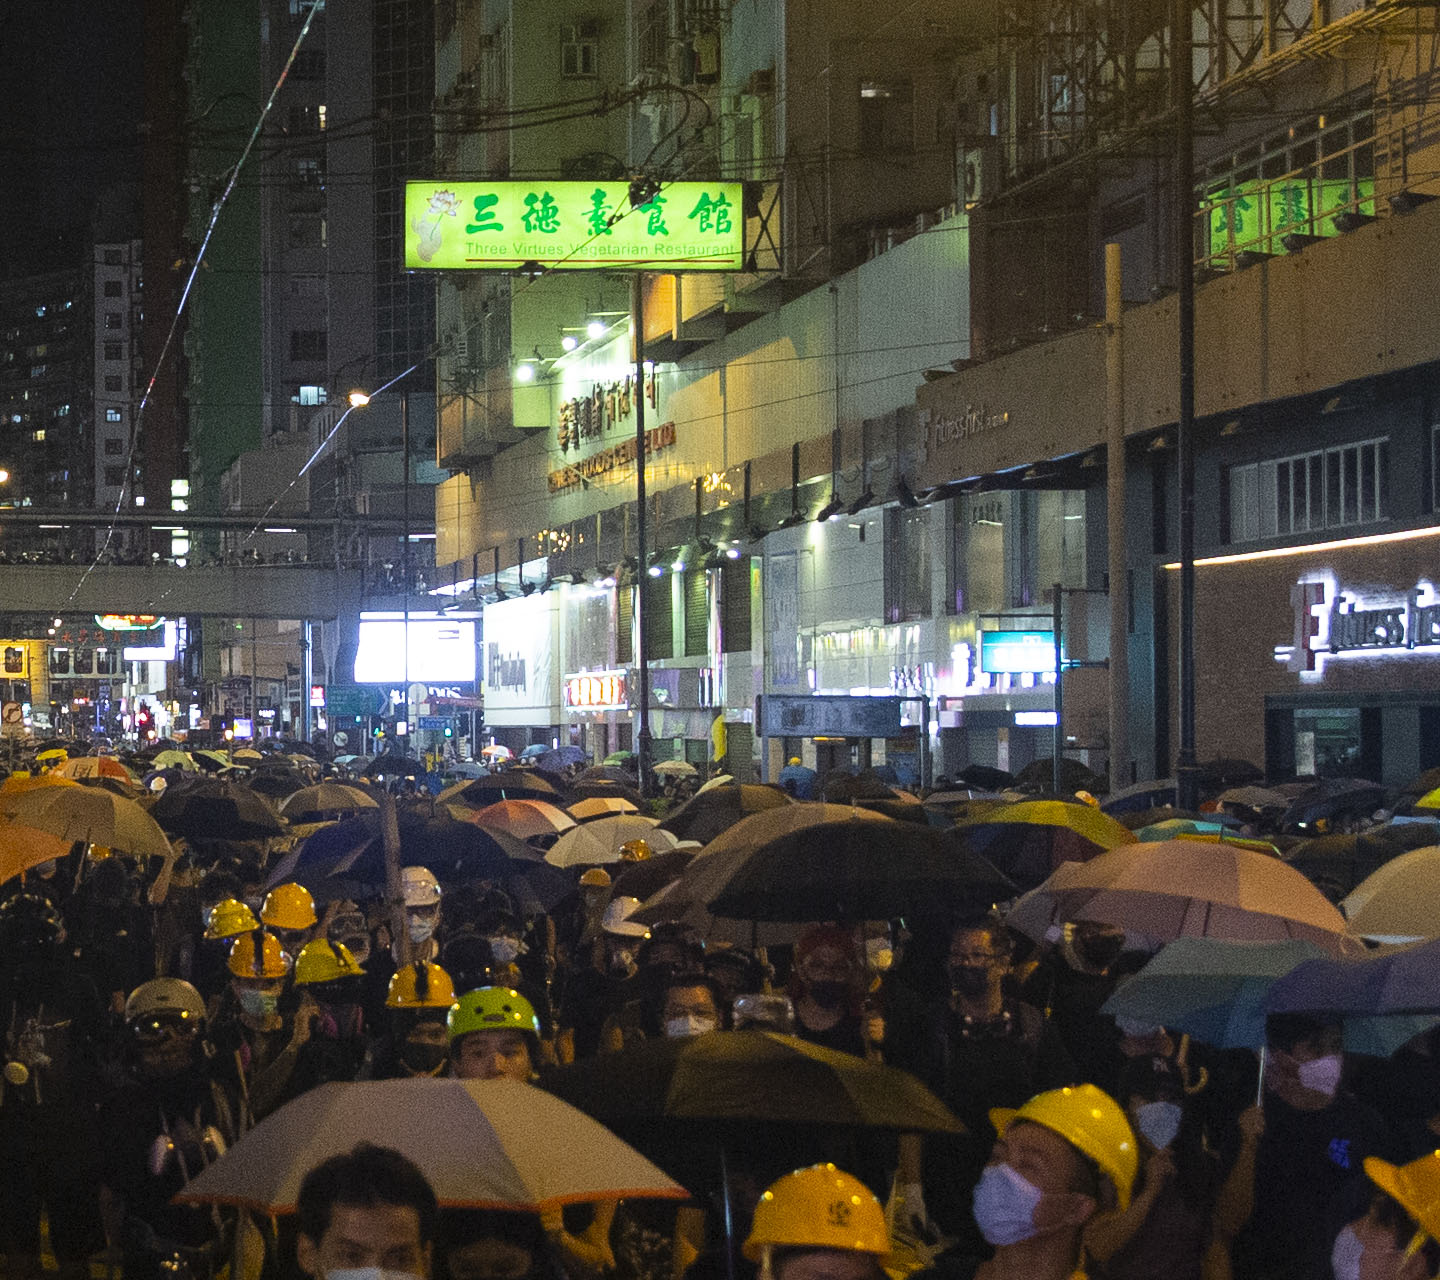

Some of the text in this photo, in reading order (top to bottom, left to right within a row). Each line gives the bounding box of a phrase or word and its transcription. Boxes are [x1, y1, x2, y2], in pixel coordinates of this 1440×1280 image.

[466, 242, 734, 258] Three Virtues Vegetarian Restaurant
